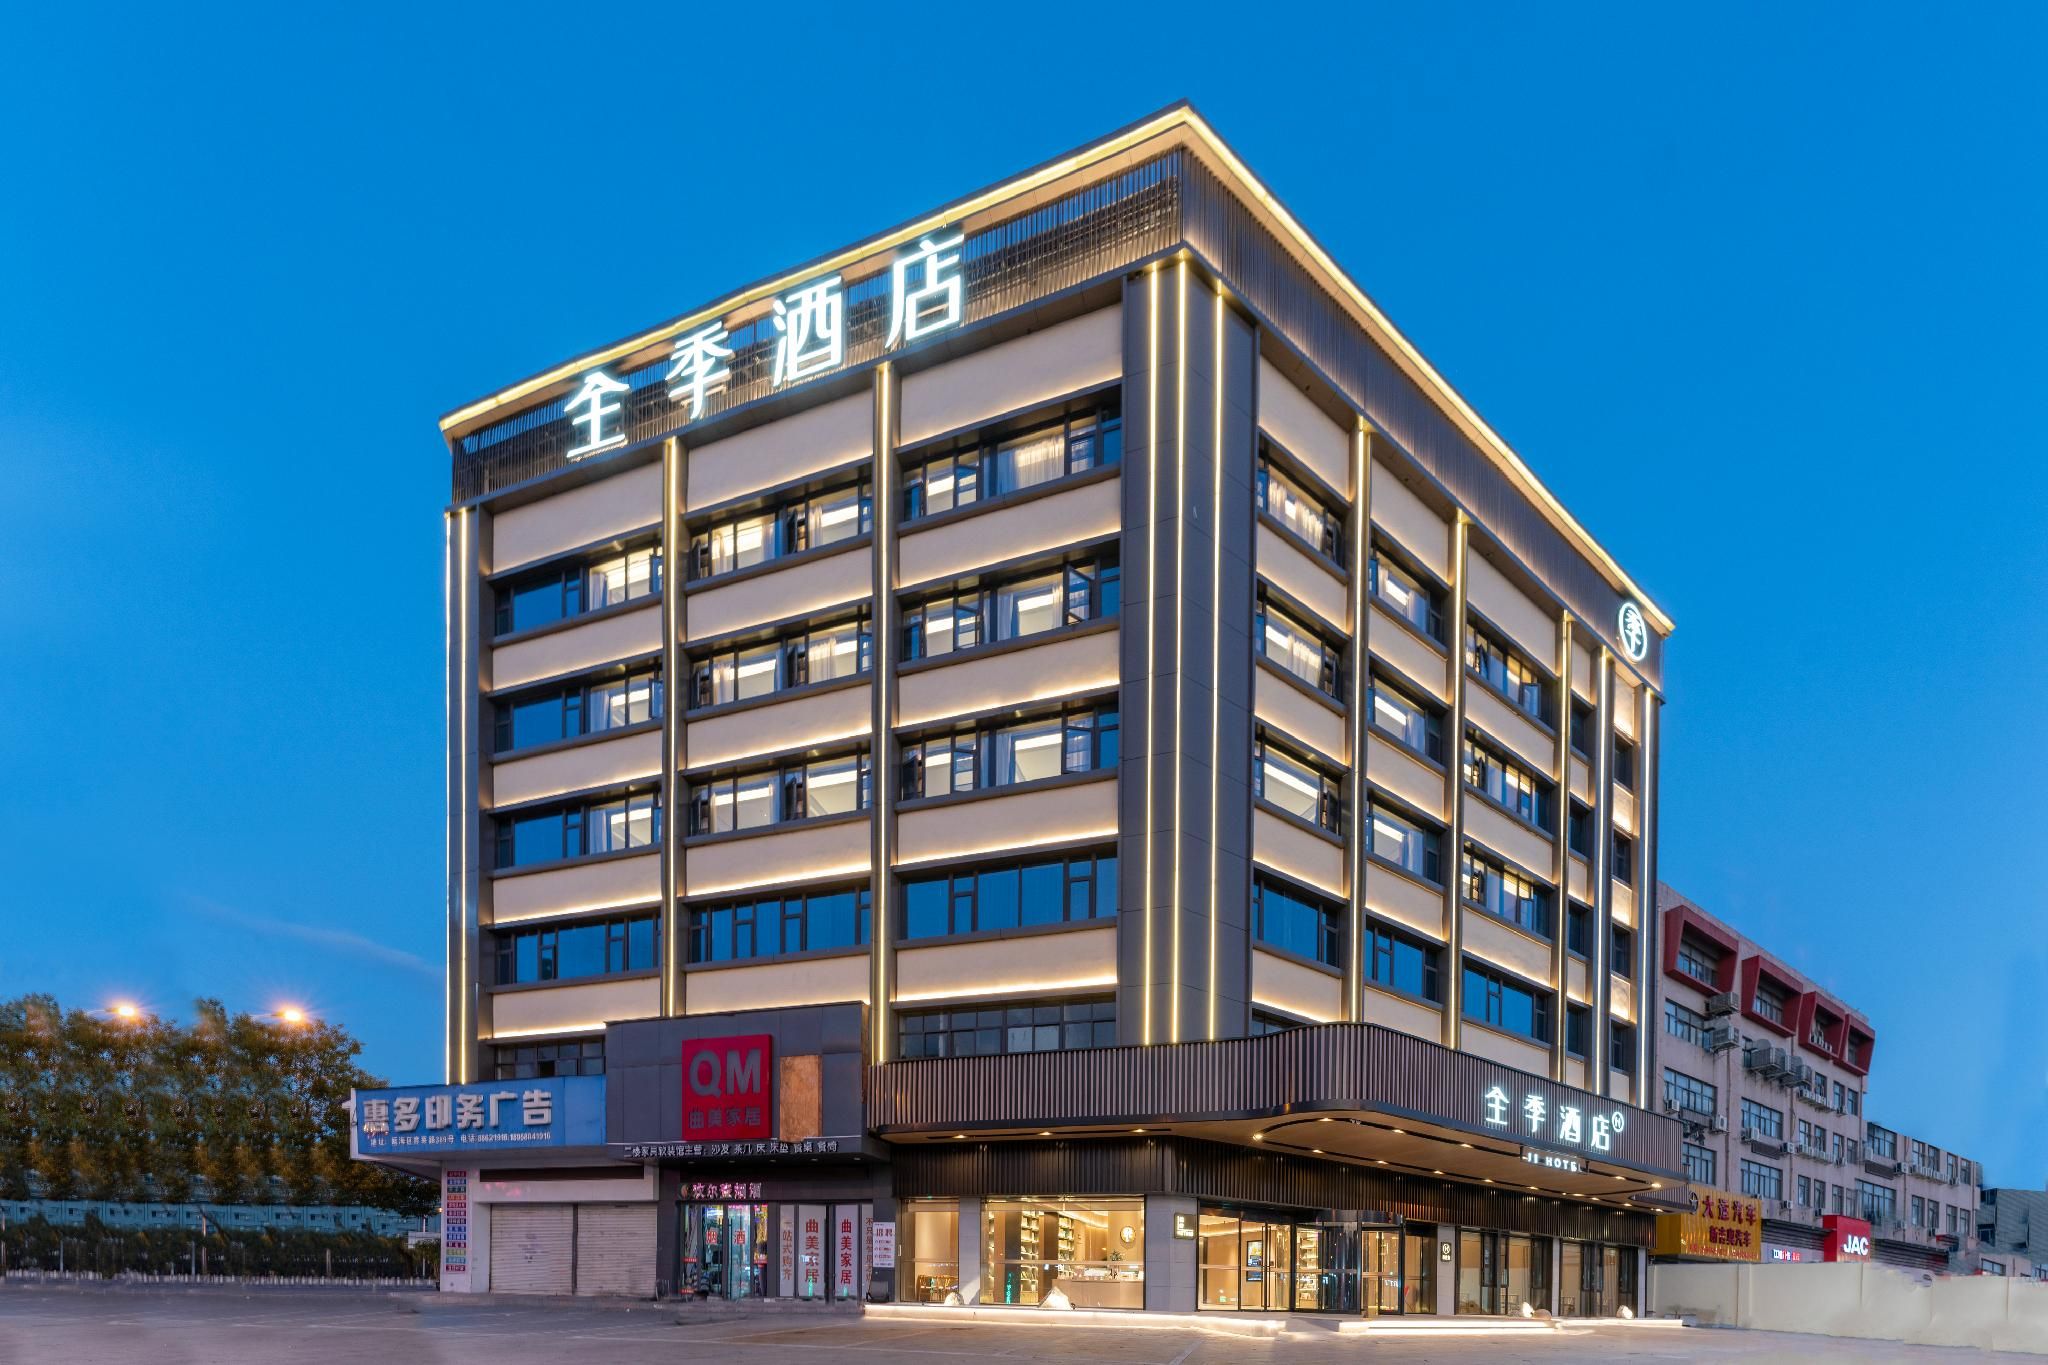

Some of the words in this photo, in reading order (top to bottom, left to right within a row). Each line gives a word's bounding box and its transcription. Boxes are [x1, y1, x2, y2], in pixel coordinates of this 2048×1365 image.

[564, 234, 965, 459] 全季酒店
[689, 1049, 762, 1098] QM
[363, 1090, 552, 1133] 惠多印务广告
[689, 1105, 761, 1129] 曲美家居
[1485, 1086, 1610, 1150] 全季酒店
[1527, 1152, 1538, 1164] JI
[1546, 1157, 1583, 1172] HOTEL
[1702, 1195, 1757, 1226] 大运汽车
[733, 1230, 746, 1245] 酒
[805, 1218, 820, 1284] 曲美家居
[840, 1218, 852, 1285] 曲美家居
[1843, 1234, 1869, 1256] JAC
